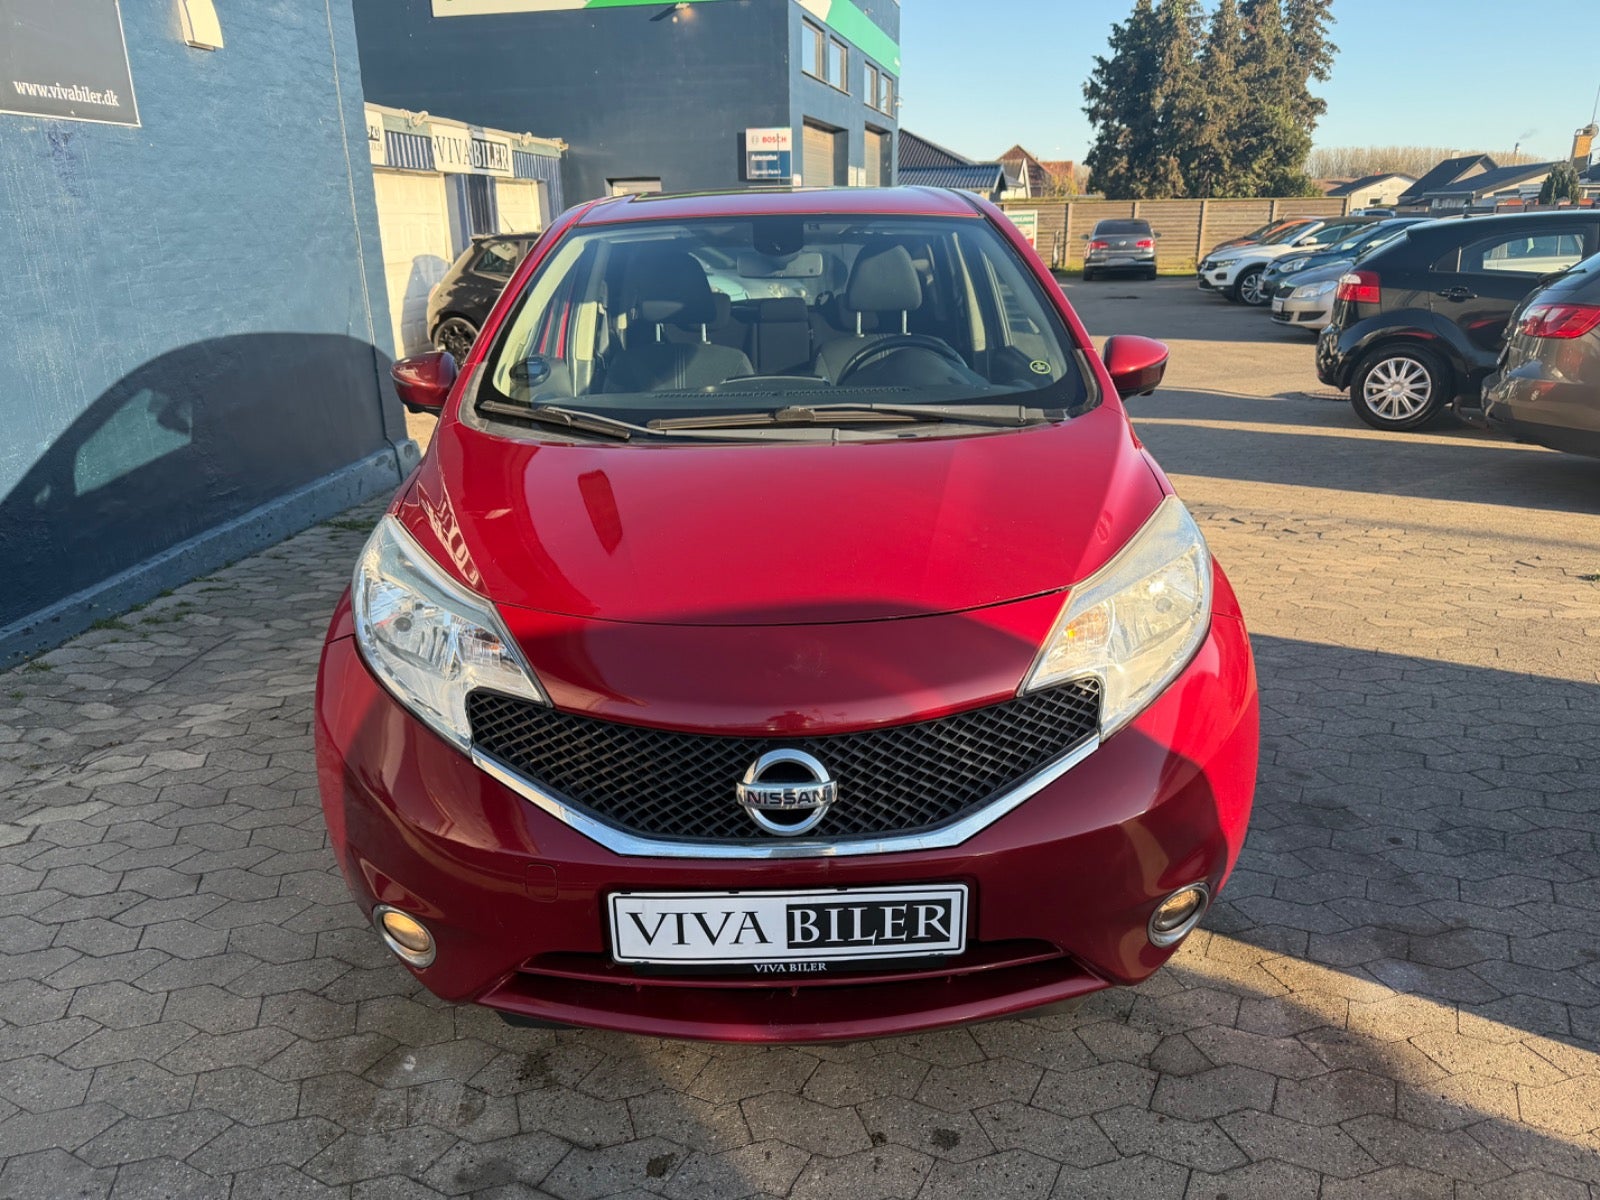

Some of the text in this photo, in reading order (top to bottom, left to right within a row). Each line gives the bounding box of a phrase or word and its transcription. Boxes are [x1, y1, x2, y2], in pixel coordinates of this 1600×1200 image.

[12, 81, 120, 107] www.vivabiler.dk
[762, 136, 787, 144] BOSCH
[435, 135, 510, 169] VIVA BILER
[746, 788, 827, 805] NISSAN
[625, 903, 951, 946] VIVA BILER
[753, 962, 828, 973] VIVA BILER
